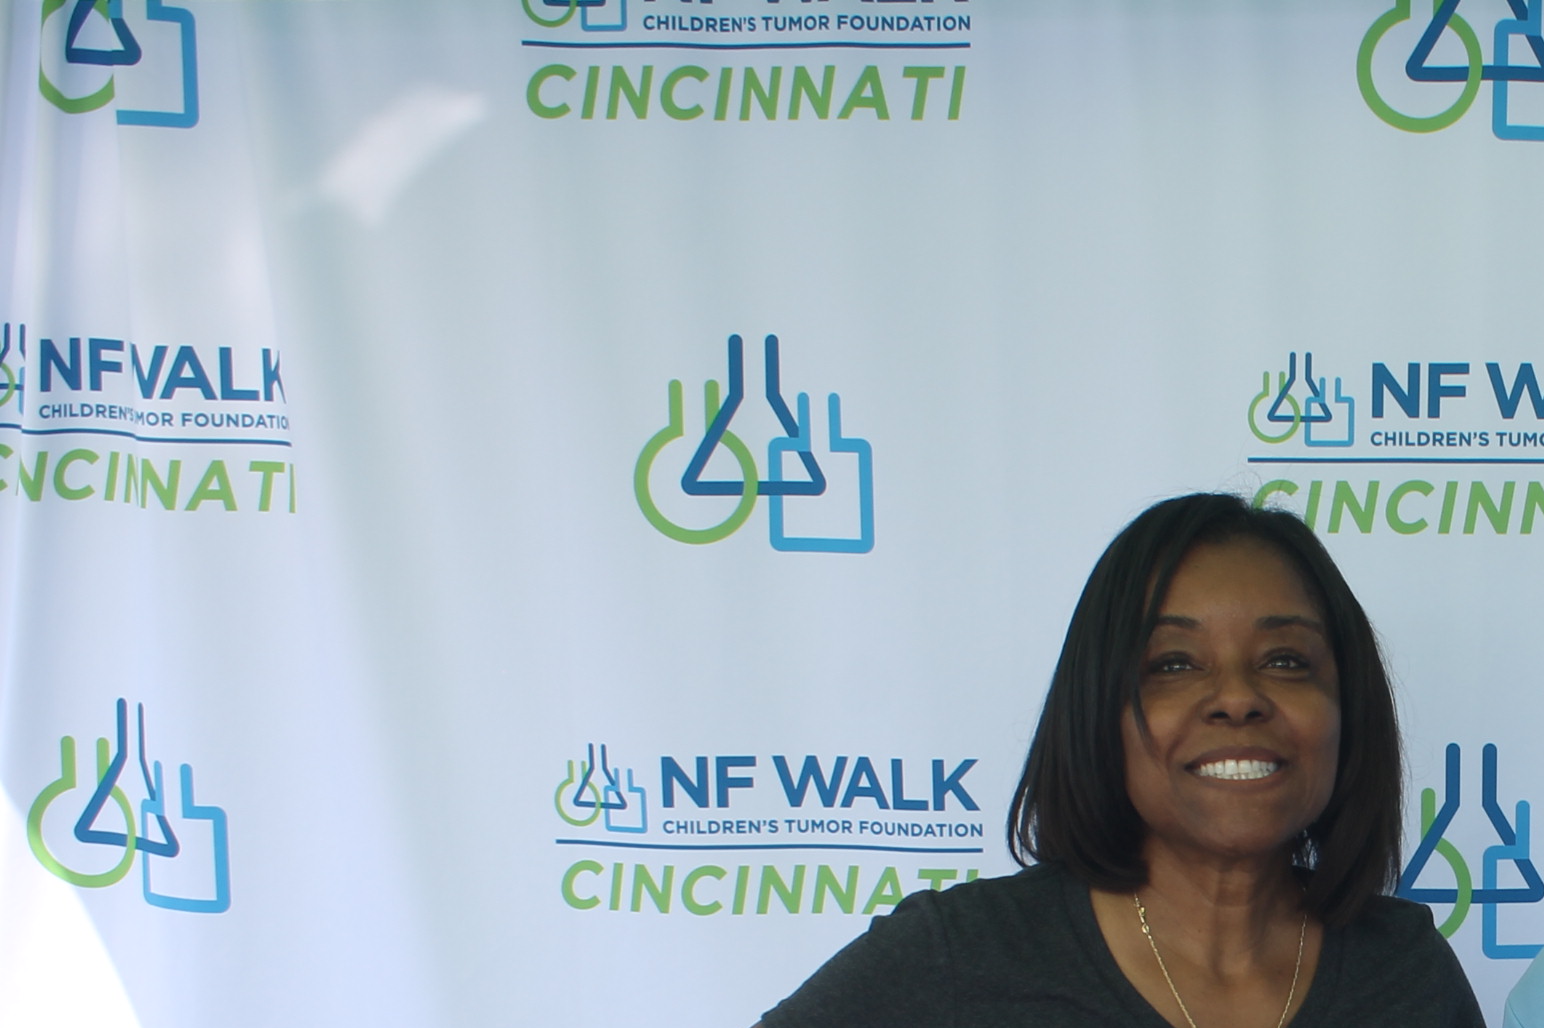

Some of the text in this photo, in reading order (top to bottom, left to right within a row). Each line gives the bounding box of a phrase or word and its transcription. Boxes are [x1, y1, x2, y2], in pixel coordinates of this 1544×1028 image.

[643, 15, 971, 32] CHILDREN'S TUMOR FOUNDATION
[526, 64, 966, 121] CINCINNATI
[40, 337, 124, 392] NF
[1371, 362, 1470, 419] NF
[39, 403, 135, 421] CHILDREN'S
[181, 412, 290, 431] FOUNDATIO
[1370, 431, 1490, 448] CHILDREN'S
[660, 755, 982, 812] NF WALK
[662, 819, 983, 838] CHILDREN'S TUMOR FOUNDATION
[561, 859, 979, 916] CINCINNAT
